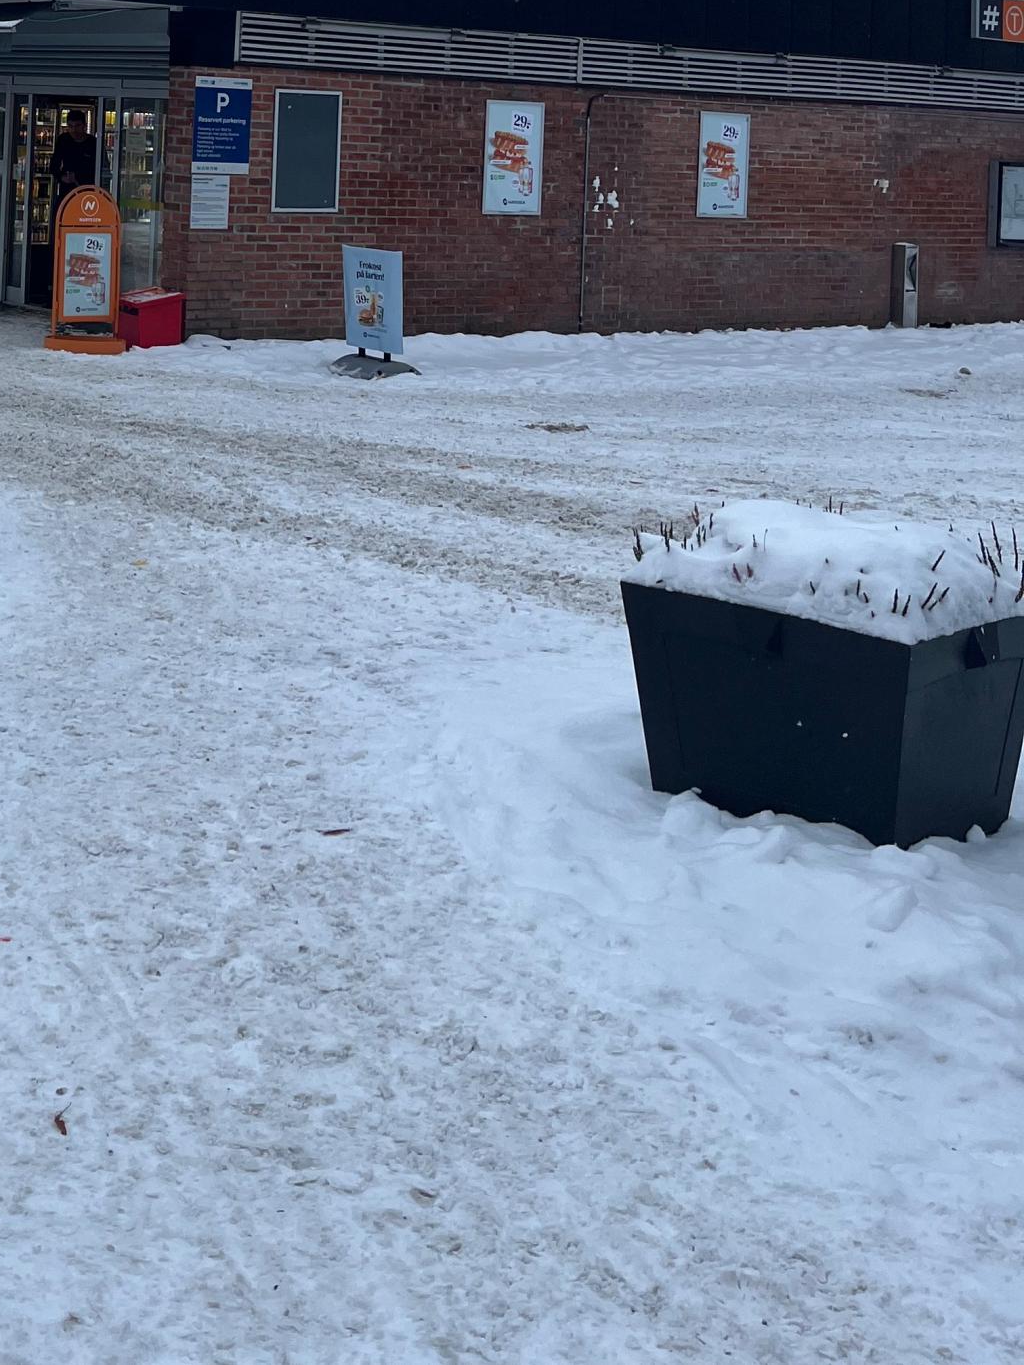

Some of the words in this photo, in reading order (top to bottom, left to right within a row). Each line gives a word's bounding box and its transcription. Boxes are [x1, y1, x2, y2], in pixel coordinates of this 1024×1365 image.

[216, 92, 230, 113] P
[198, 115, 223, 124] Reservert
[222, 116, 247, 126] parkering
[84, 201, 96, 210] N
[359, 260, 382, 271] Frokost
